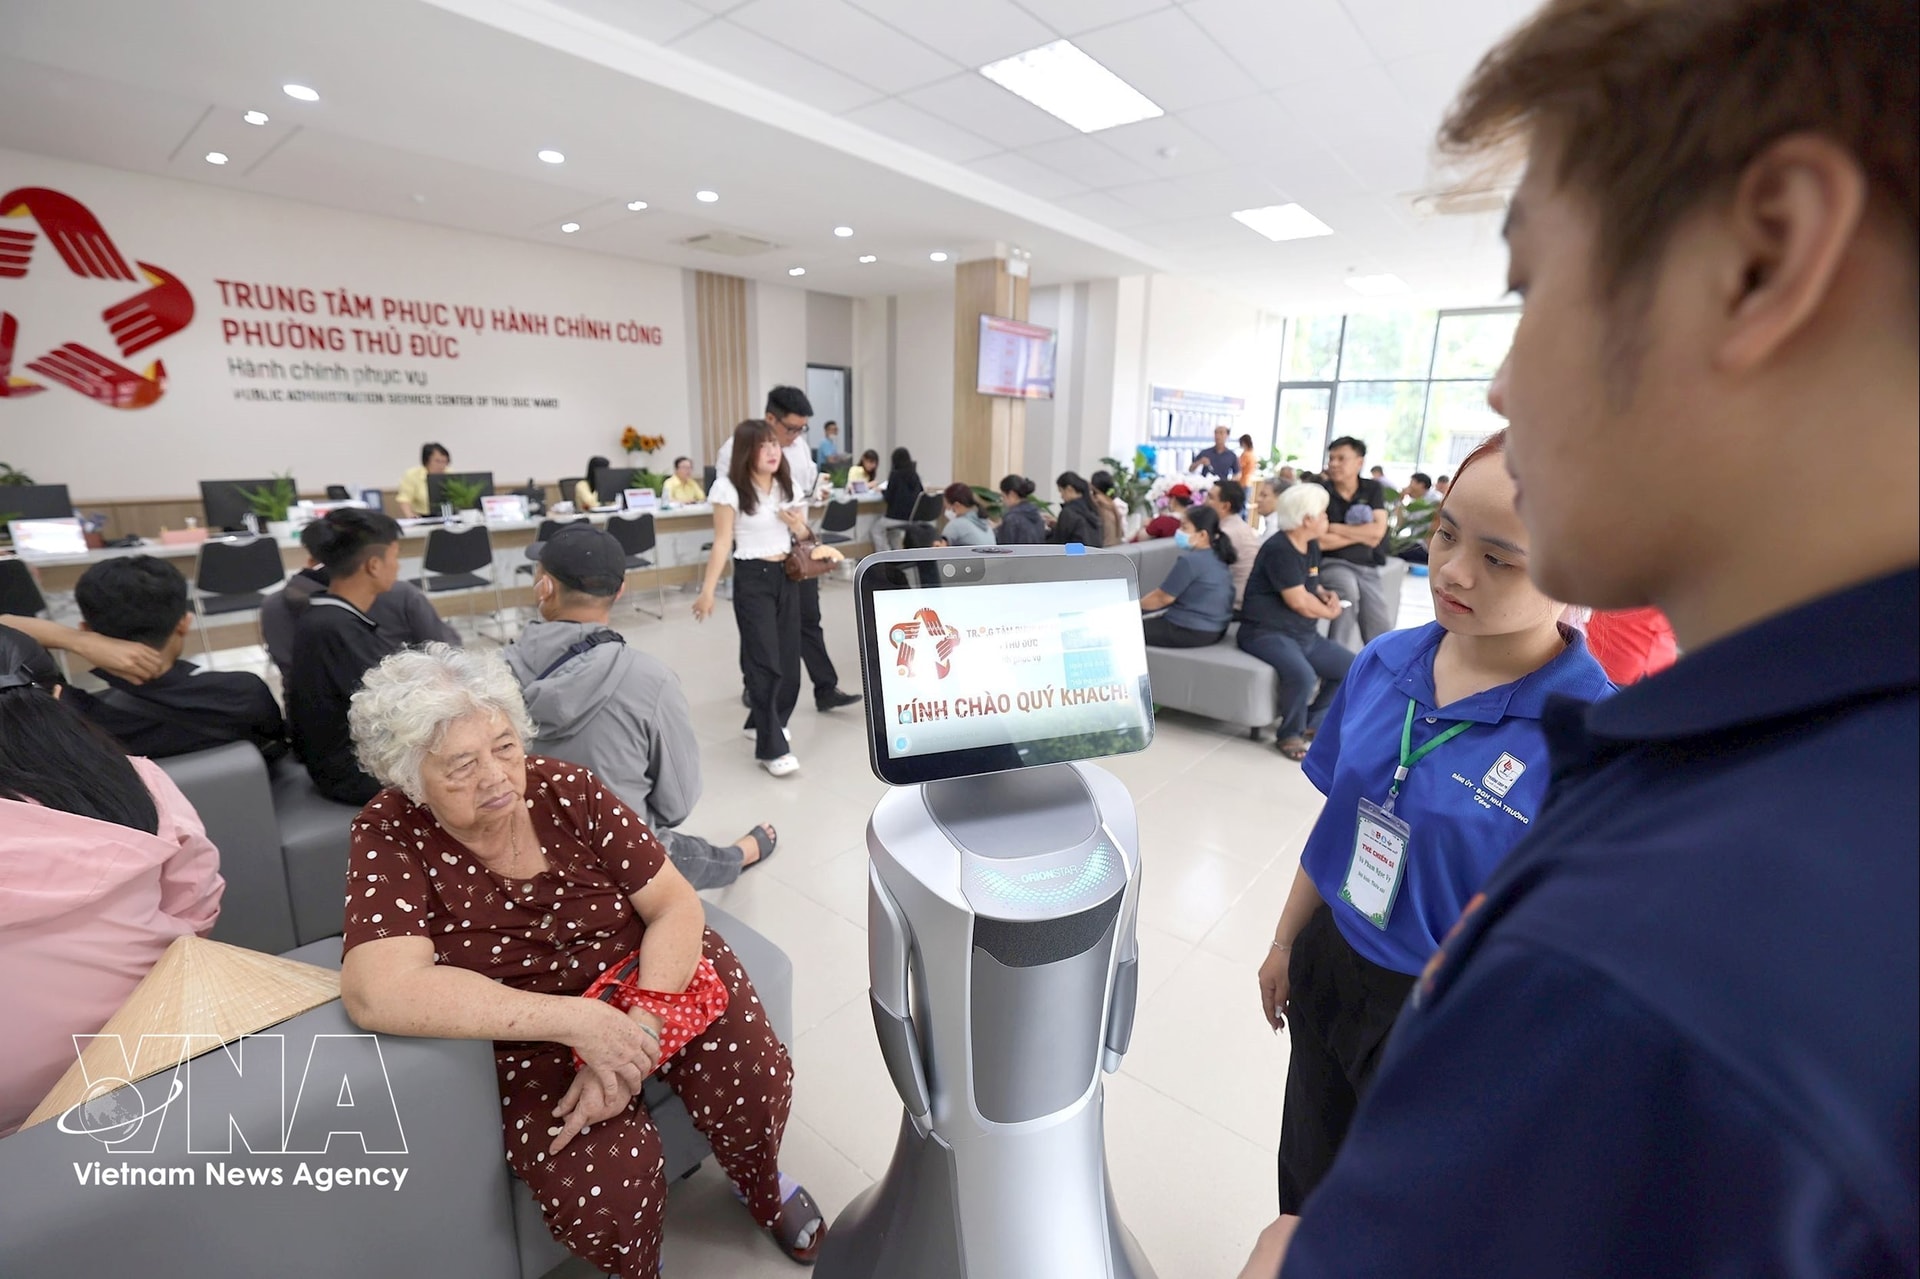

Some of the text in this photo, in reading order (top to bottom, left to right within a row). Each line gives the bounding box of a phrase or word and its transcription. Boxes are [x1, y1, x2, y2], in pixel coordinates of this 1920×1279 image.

[214, 279, 662, 346] TRUNG TÂM PHỤC VỤ HÀNH CHÍNH CÔNG
[221, 317, 460, 359] PHƯỜNG THỦ ĐỨC
[227, 357, 286, 379] Hành
[233, 387, 284, 402] PUBLIC
[966, 627, 994, 638] TRG
[897, 697, 949, 725] KÍNH
[954, 691, 1011, 719] CHÀO
[1016, 684, 1054, 713] QUÝ
[1020, 864, 1078, 884] ORIONSTAR
